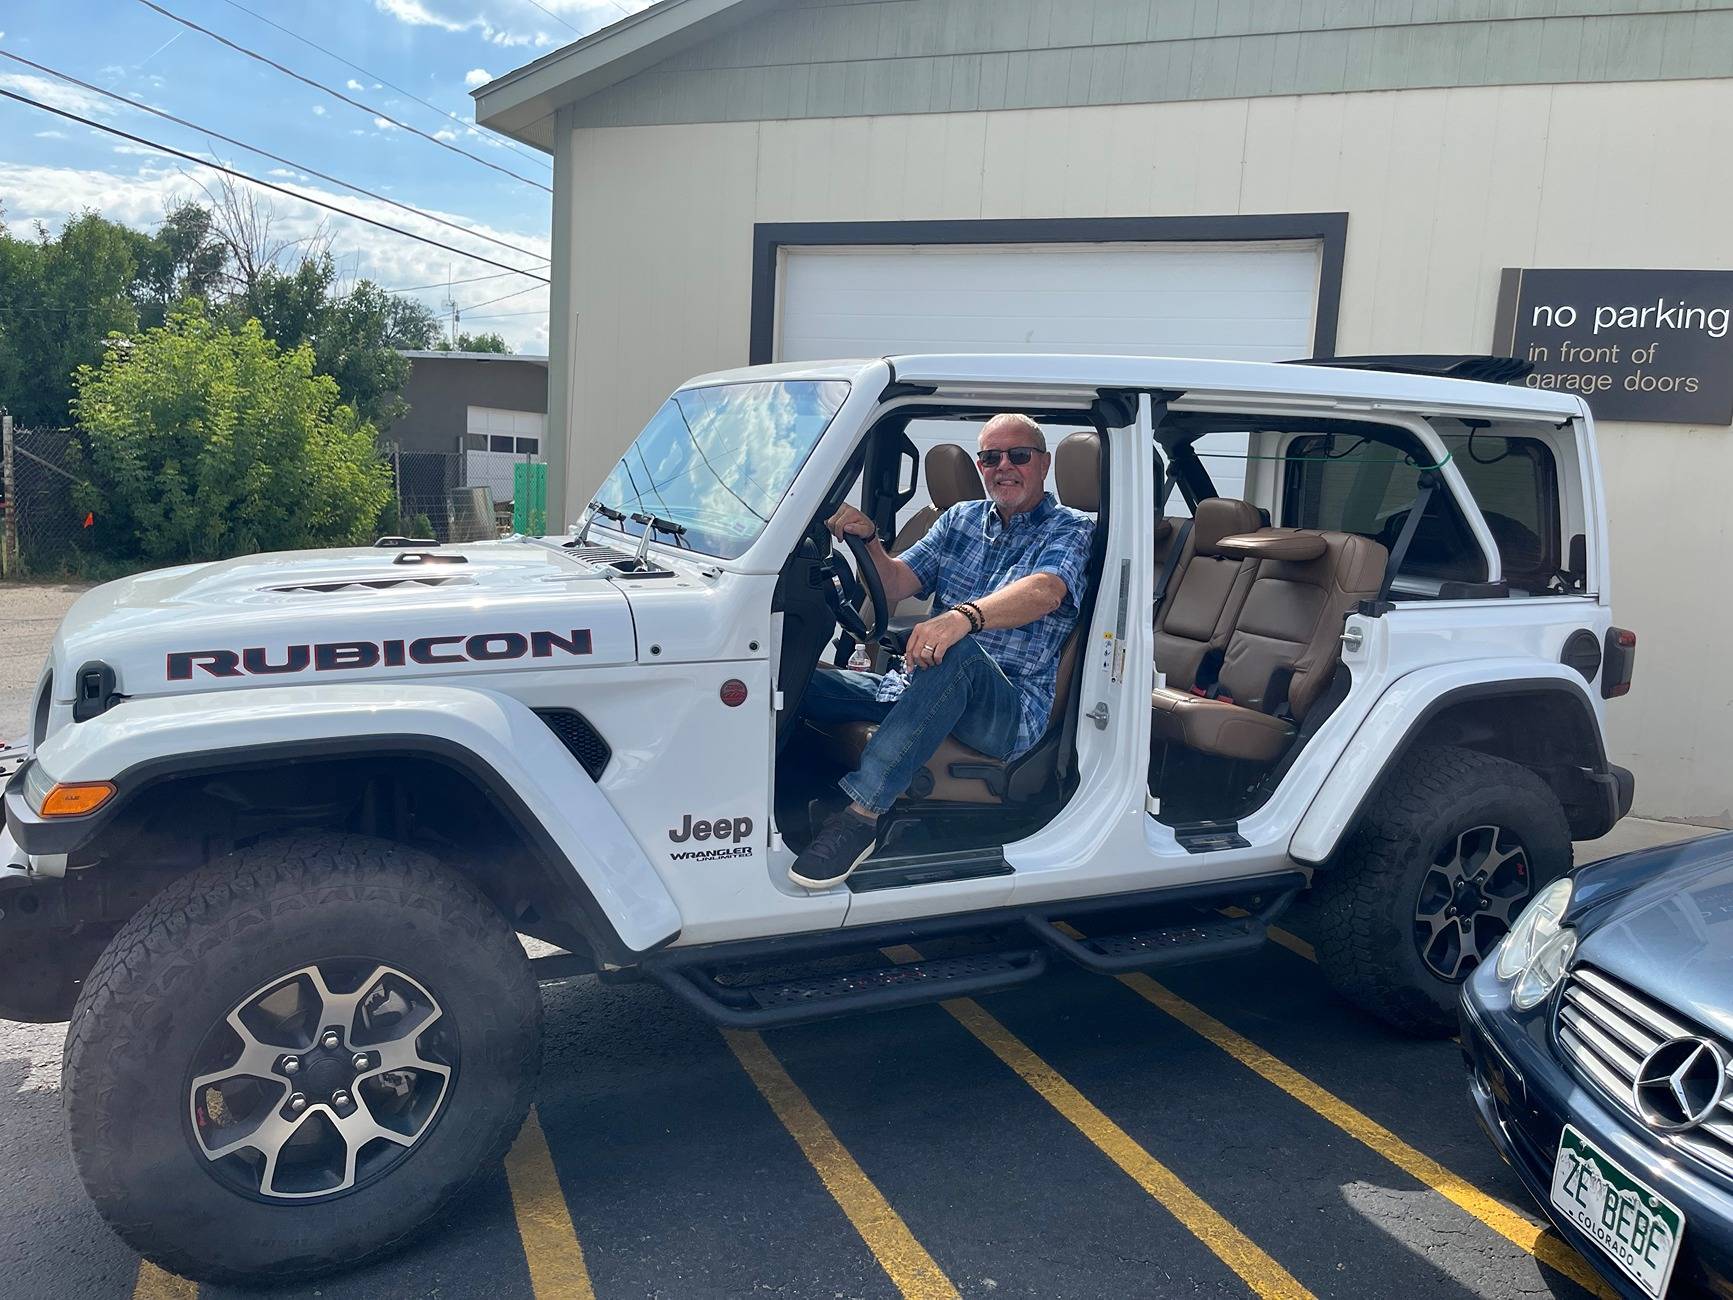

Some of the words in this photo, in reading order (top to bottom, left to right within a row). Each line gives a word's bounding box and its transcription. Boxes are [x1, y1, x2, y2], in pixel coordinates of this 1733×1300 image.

[1531, 304, 1577, 328] no
[1593, 298, 1730, 338] parking
[1528, 342, 1548, 362] in
[1560, 341, 1620, 364] front
[1631, 342, 1659, 364] of
[1525, 372, 1613, 394] garage
[1624, 370, 1699, 393] doors
[166, 628, 593, 681] RUBICON
[668, 814, 753, 844] Jeep
[670, 846, 753, 861] WRANGLER
[696, 853, 753, 862] UNLIMITED
[1562, 1153, 1593, 1209] ZE
[1601, 1184, 1666, 1270] BEBE
[1578, 1211, 1635, 1266] COLORADO
